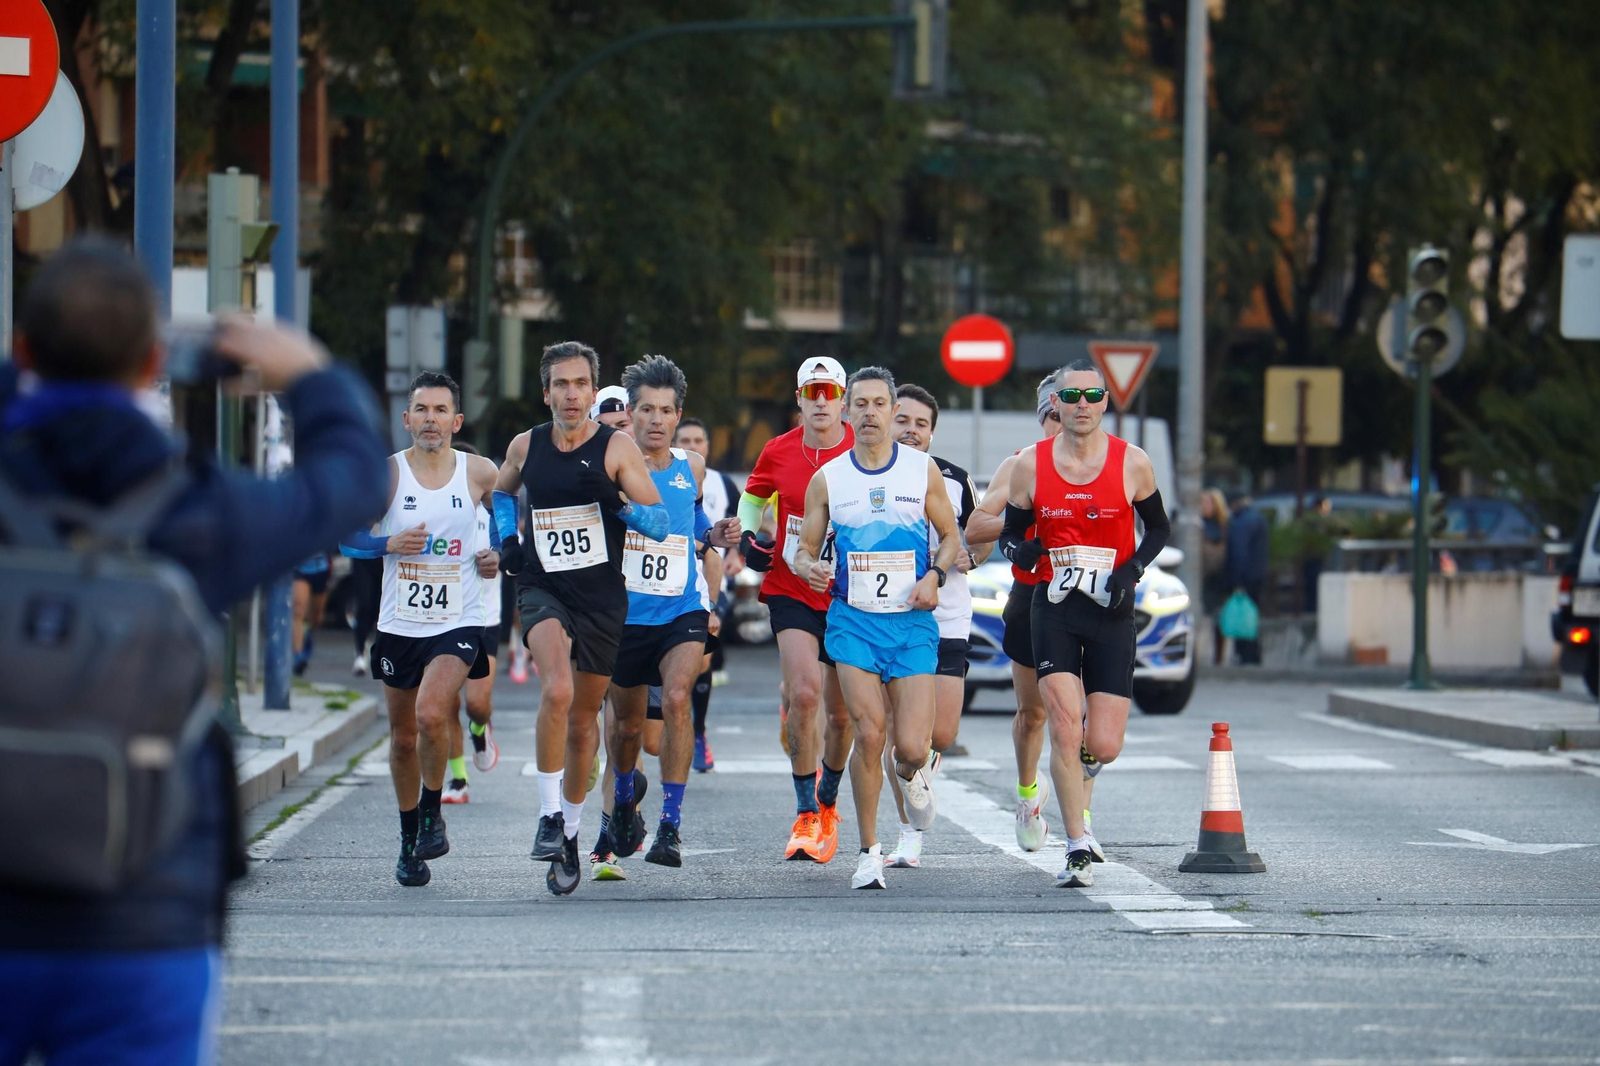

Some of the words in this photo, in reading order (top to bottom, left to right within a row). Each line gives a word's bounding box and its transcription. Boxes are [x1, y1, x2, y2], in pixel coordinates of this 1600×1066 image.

[895, 495, 921, 504] DISMAC
[535, 511, 554, 530] XLI
[1048, 508, 1073, 516] califas
[547, 528, 591, 557] 295
[399, 562, 418, 581] XLI
[641, 553, 669, 581] 68
[851, 554, 870, 571] XLI
[876, 573, 888, 598] 2
[1059, 567, 1098, 594] 271
[407, 582, 449, 609] 234
